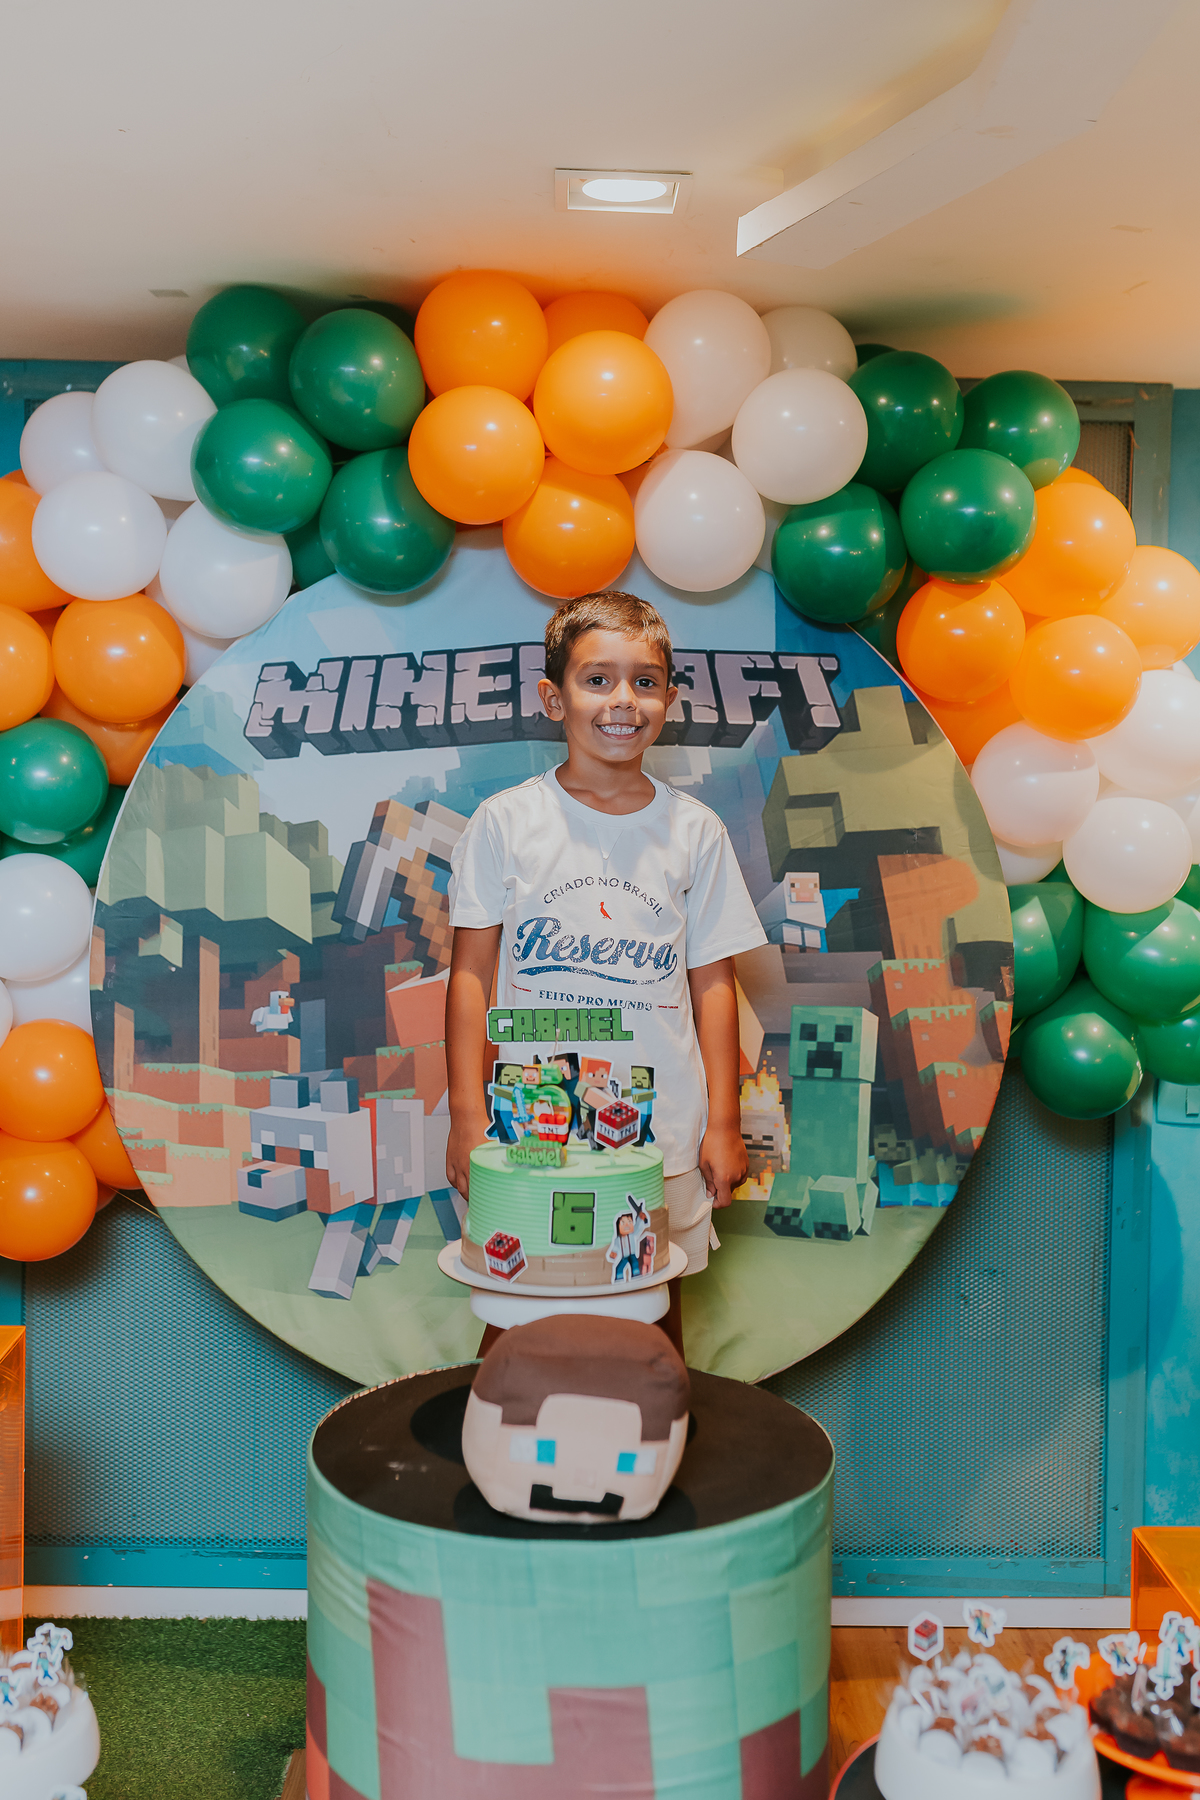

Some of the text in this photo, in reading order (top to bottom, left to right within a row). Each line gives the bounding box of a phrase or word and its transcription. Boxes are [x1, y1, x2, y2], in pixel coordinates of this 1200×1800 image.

[244, 642, 840, 759] MINEAFT
[543, 876, 663, 918] CRIADO NO BRASIL
[511, 916, 678, 972] Reserva
[538, 989, 653, 1012] FEITO PRO MUNDO
[488, 1007, 634, 1043] GABRIEL
[542, 1126, 560, 1135] TNT
[599, 1123, 637, 1139] TNT TNT
[506, 1146, 562, 1167] Gabriel
[551, 1192, 596, 1245] 6
